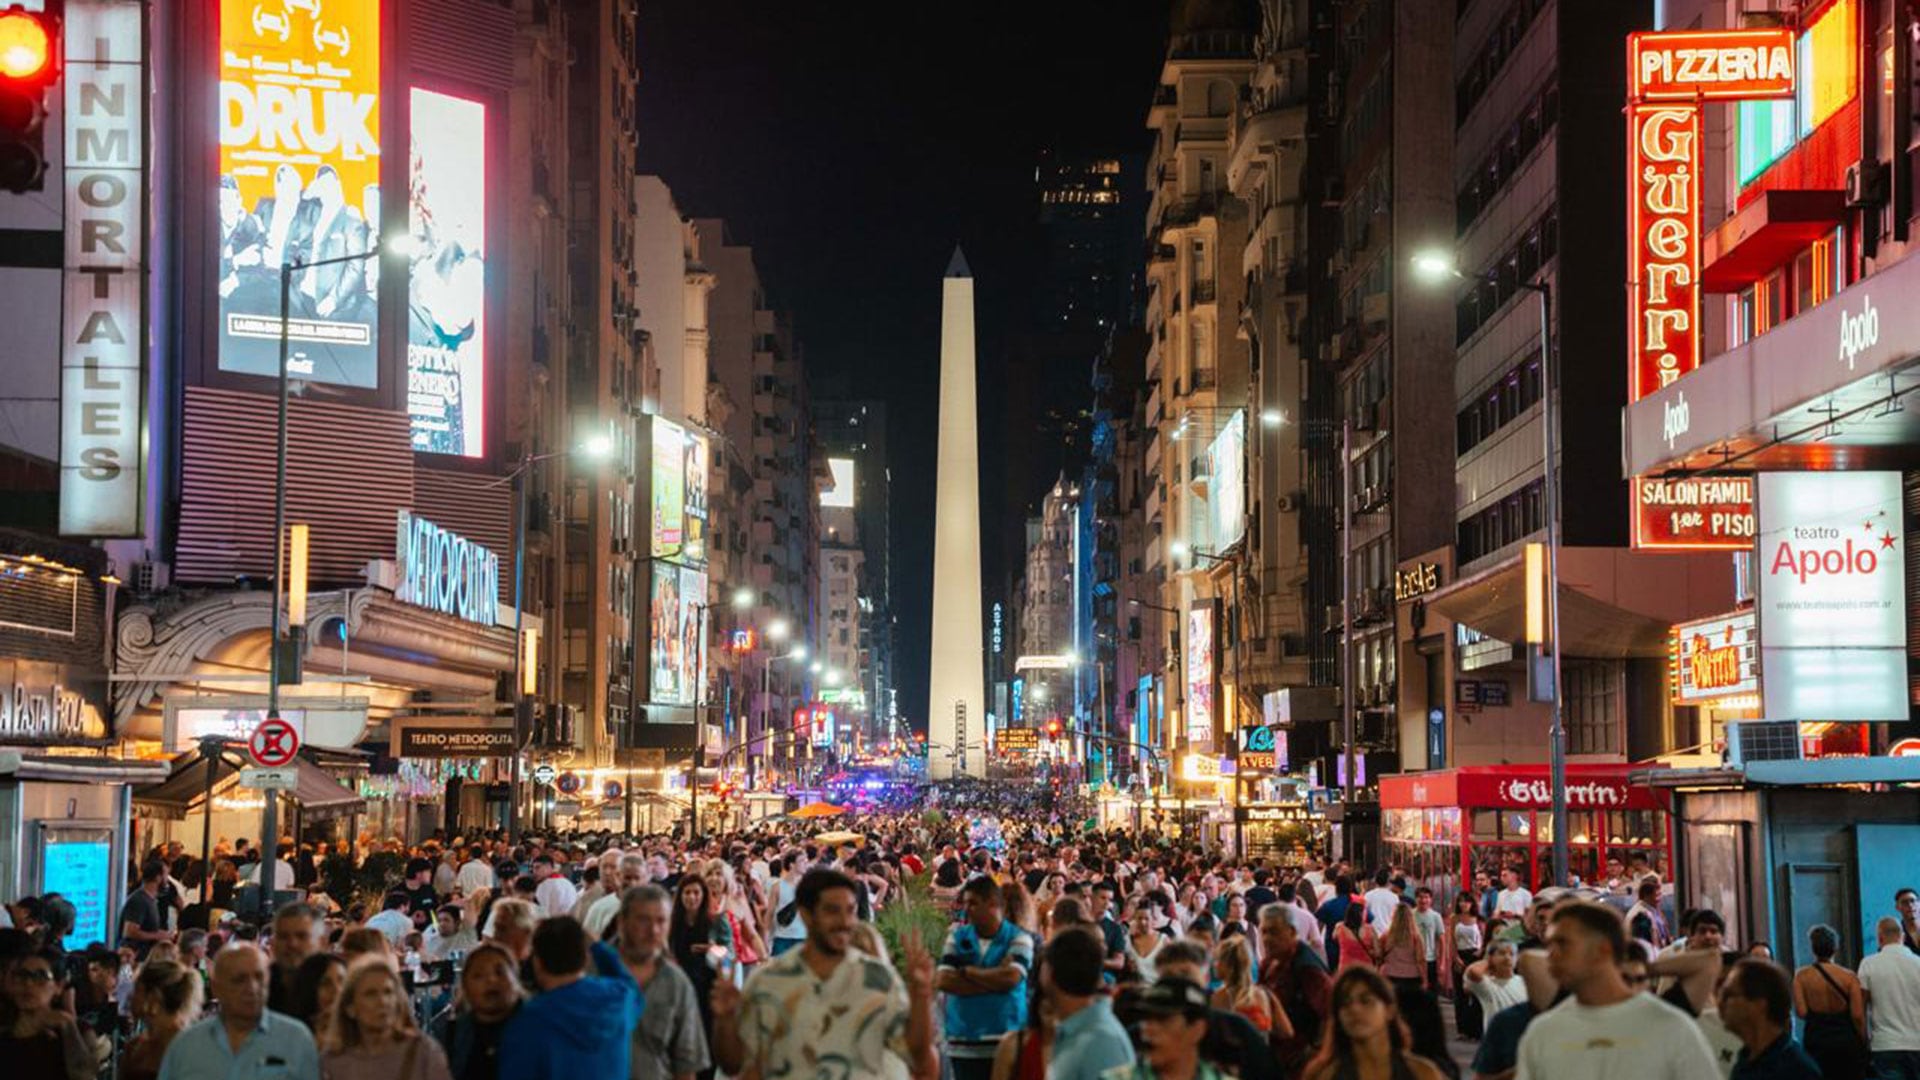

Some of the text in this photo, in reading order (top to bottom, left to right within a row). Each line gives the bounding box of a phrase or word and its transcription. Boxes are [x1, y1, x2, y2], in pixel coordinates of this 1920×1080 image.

[1641, 46, 1792, 84] PIZZERIA
[220, 81, 381, 160] DRUK
[75, 37, 129, 481] INMORTALES
[1839, 294, 1878, 370] Apolo
[1663, 390, 1690, 450] Apolo
[1643, 482, 1699, 504] SALON
[1711, 512, 1754, 536] PISO
[1794, 526, 1840, 540] teatro
[404, 514, 499, 626] METROPOLITAN
[1770, 538, 1878, 584] Apolo
[14, 681, 50, 738] PASTA
[411, 734, 446, 745] TEATRO
[1248, 808, 1285, 819] Parrilla
[1509, 780, 1618, 805] Gürrin
